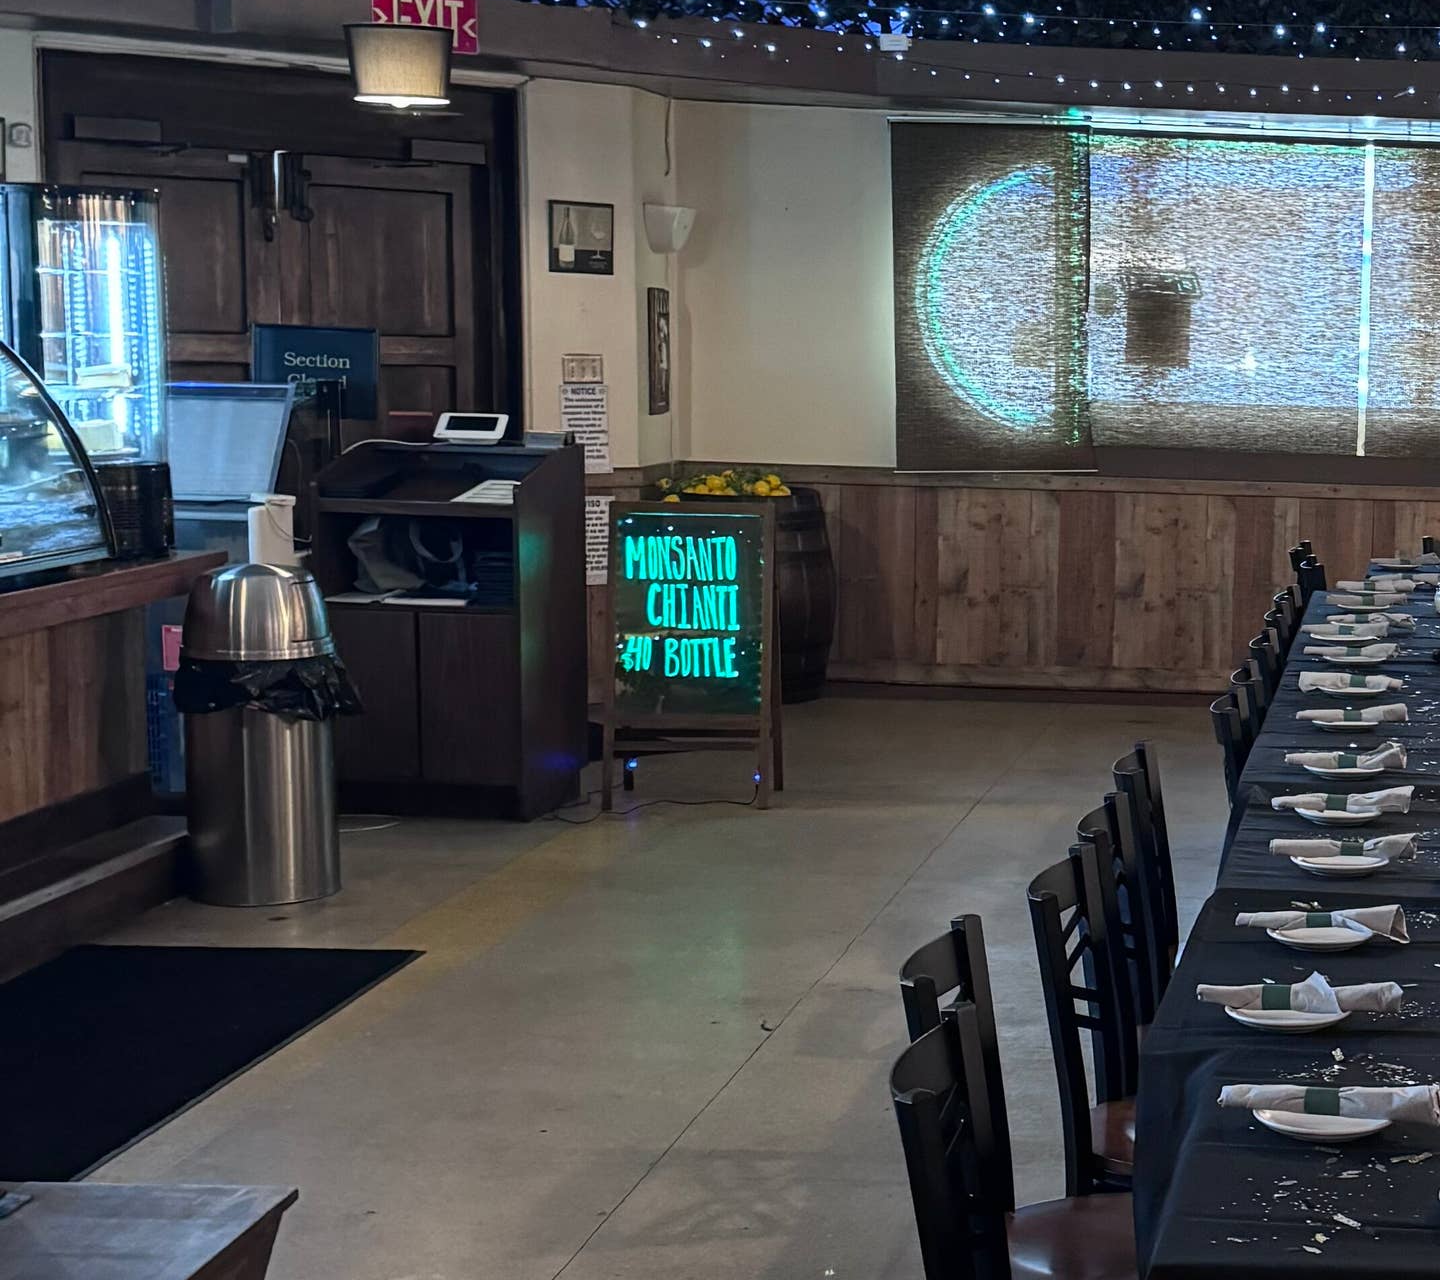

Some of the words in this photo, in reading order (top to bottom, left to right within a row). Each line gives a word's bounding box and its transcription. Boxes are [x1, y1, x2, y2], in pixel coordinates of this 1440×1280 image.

[284, 351, 351, 369] Section
[571, 387, 596, 395] NOTICE
[624, 535, 737, 581] MONSANTO
[646, 582, 741, 631] CHIANTI
[620, 635, 653, 672] $40
[664, 637, 740, 678] BOTTLE
